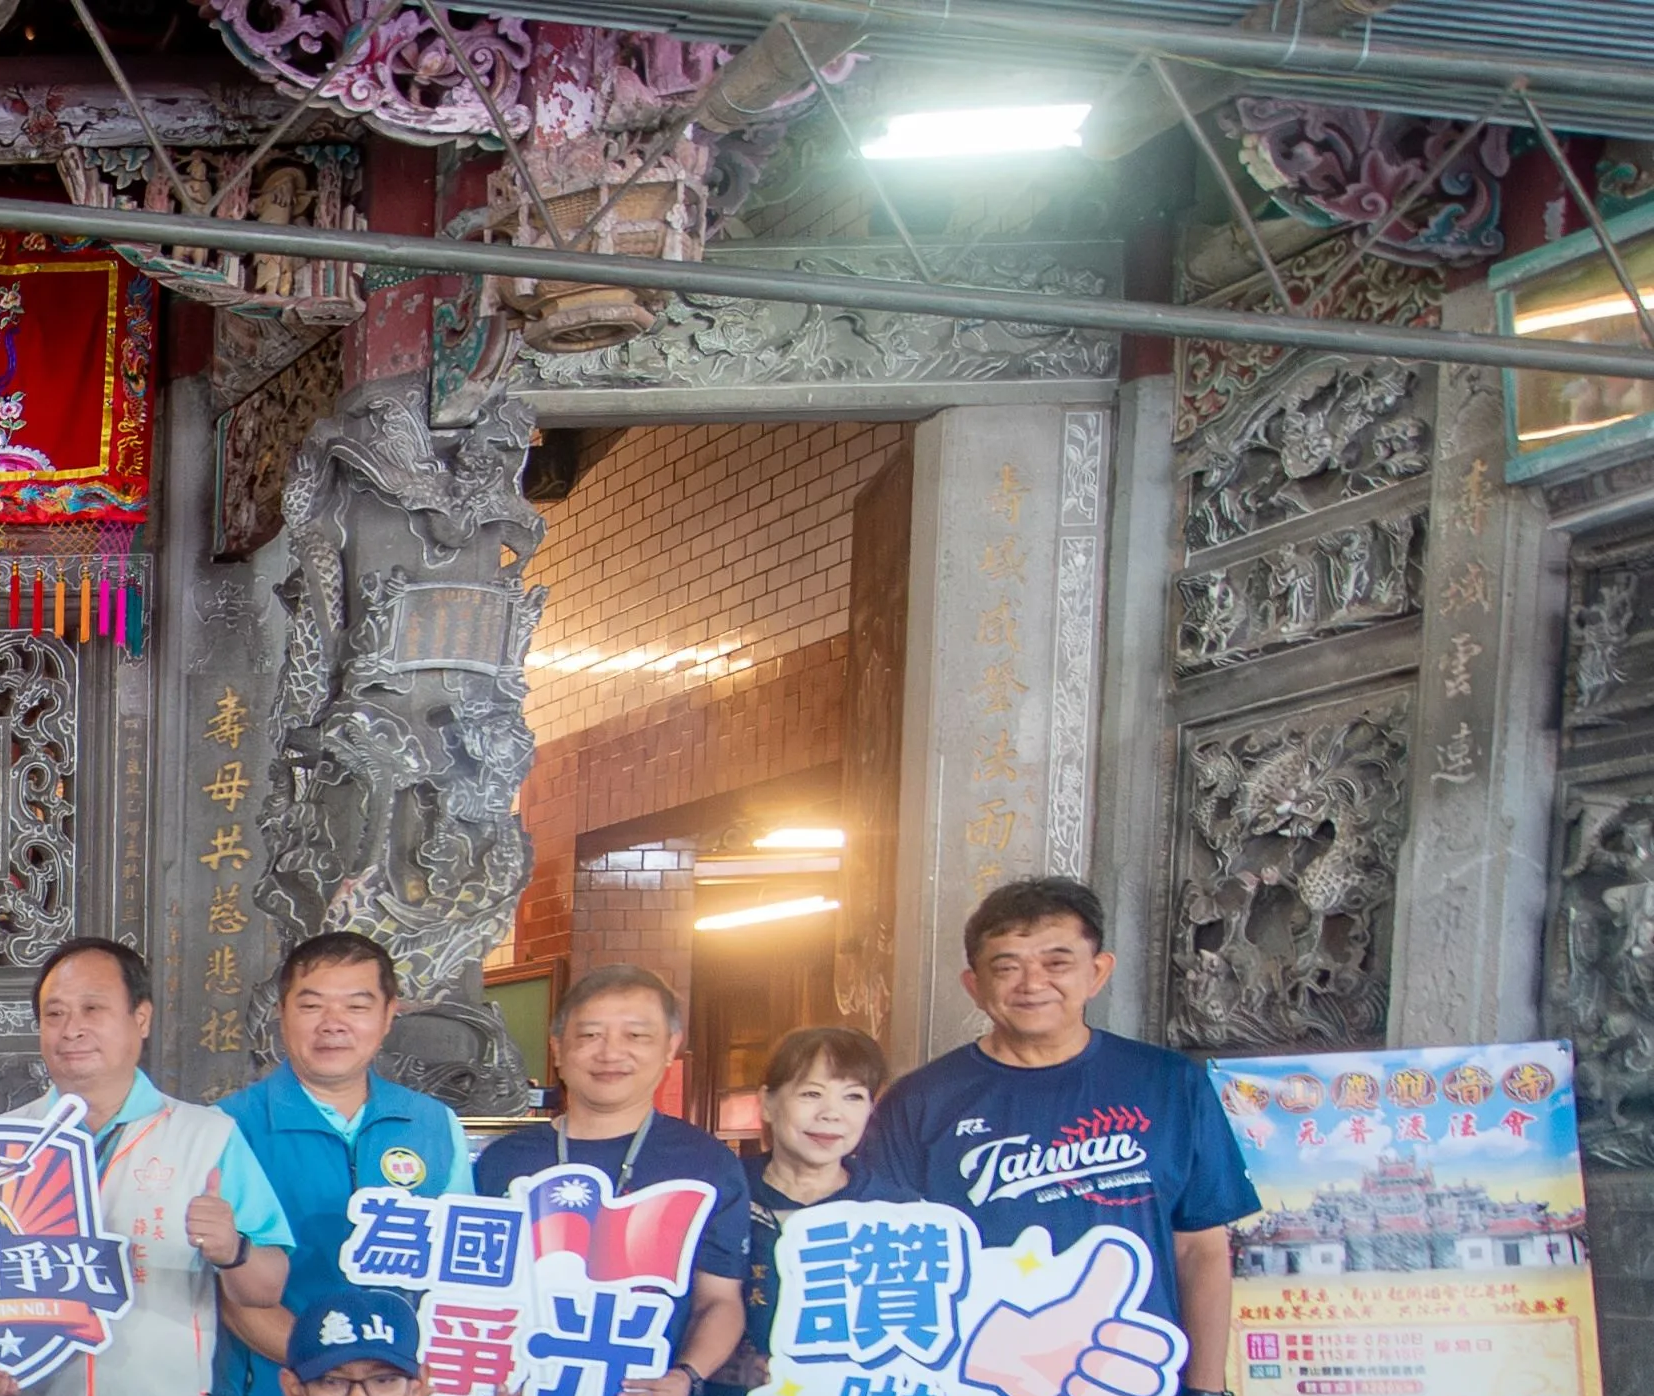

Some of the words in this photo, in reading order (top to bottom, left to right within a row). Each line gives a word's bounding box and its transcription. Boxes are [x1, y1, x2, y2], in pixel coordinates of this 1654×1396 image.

[959, 1133, 1148, 1207] Taiwan
[351, 1198, 523, 1288] 為國
[795, 1221, 950, 1366] 讚
